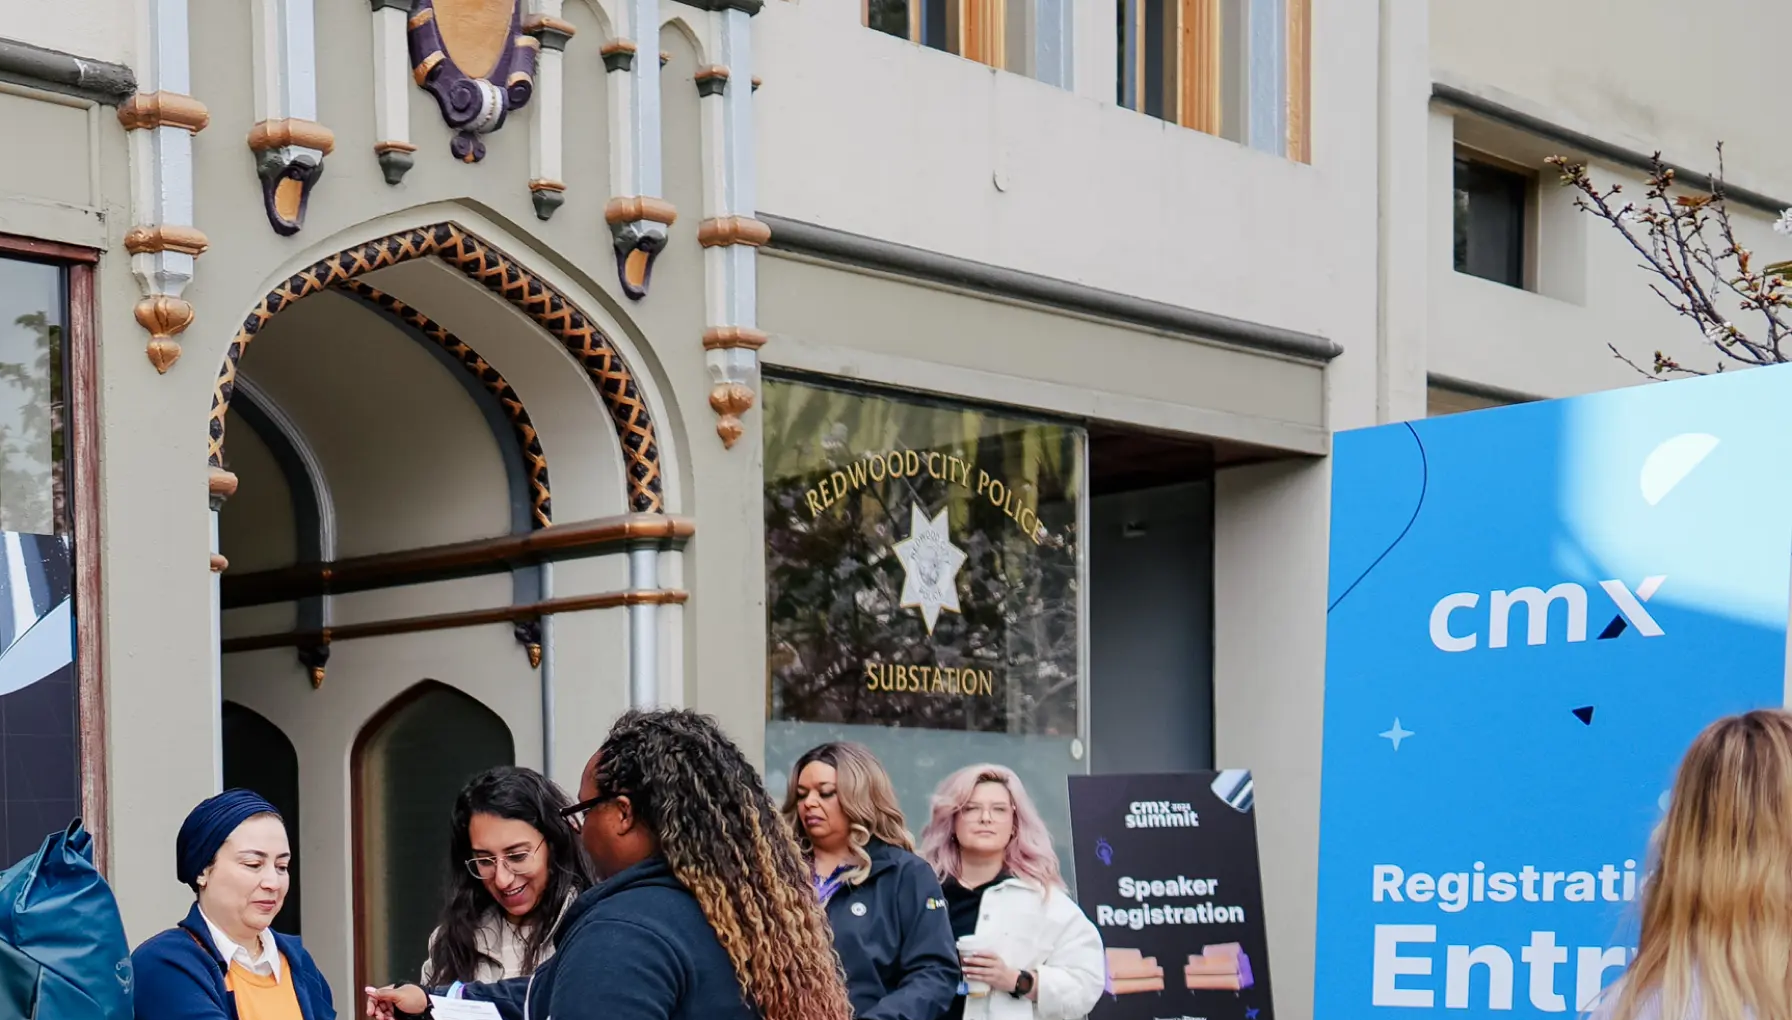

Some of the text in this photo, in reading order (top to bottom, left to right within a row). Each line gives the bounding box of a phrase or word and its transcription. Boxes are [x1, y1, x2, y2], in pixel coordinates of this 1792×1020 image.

[805, 449, 1045, 545] REDWOOD CITY POLICE
[1429, 574, 1669, 653] cmx
[866, 662, 993, 697] SUBSTATION
[1124, 809, 1200, 828] summit
[1129, 800, 1170, 815] cmx
[1118, 875, 1219, 902] Speaker
[1372, 858, 1642, 913] Registrati
[1096, 901, 1245, 930] Registration
[1372, 923, 1628, 1013] Entr
